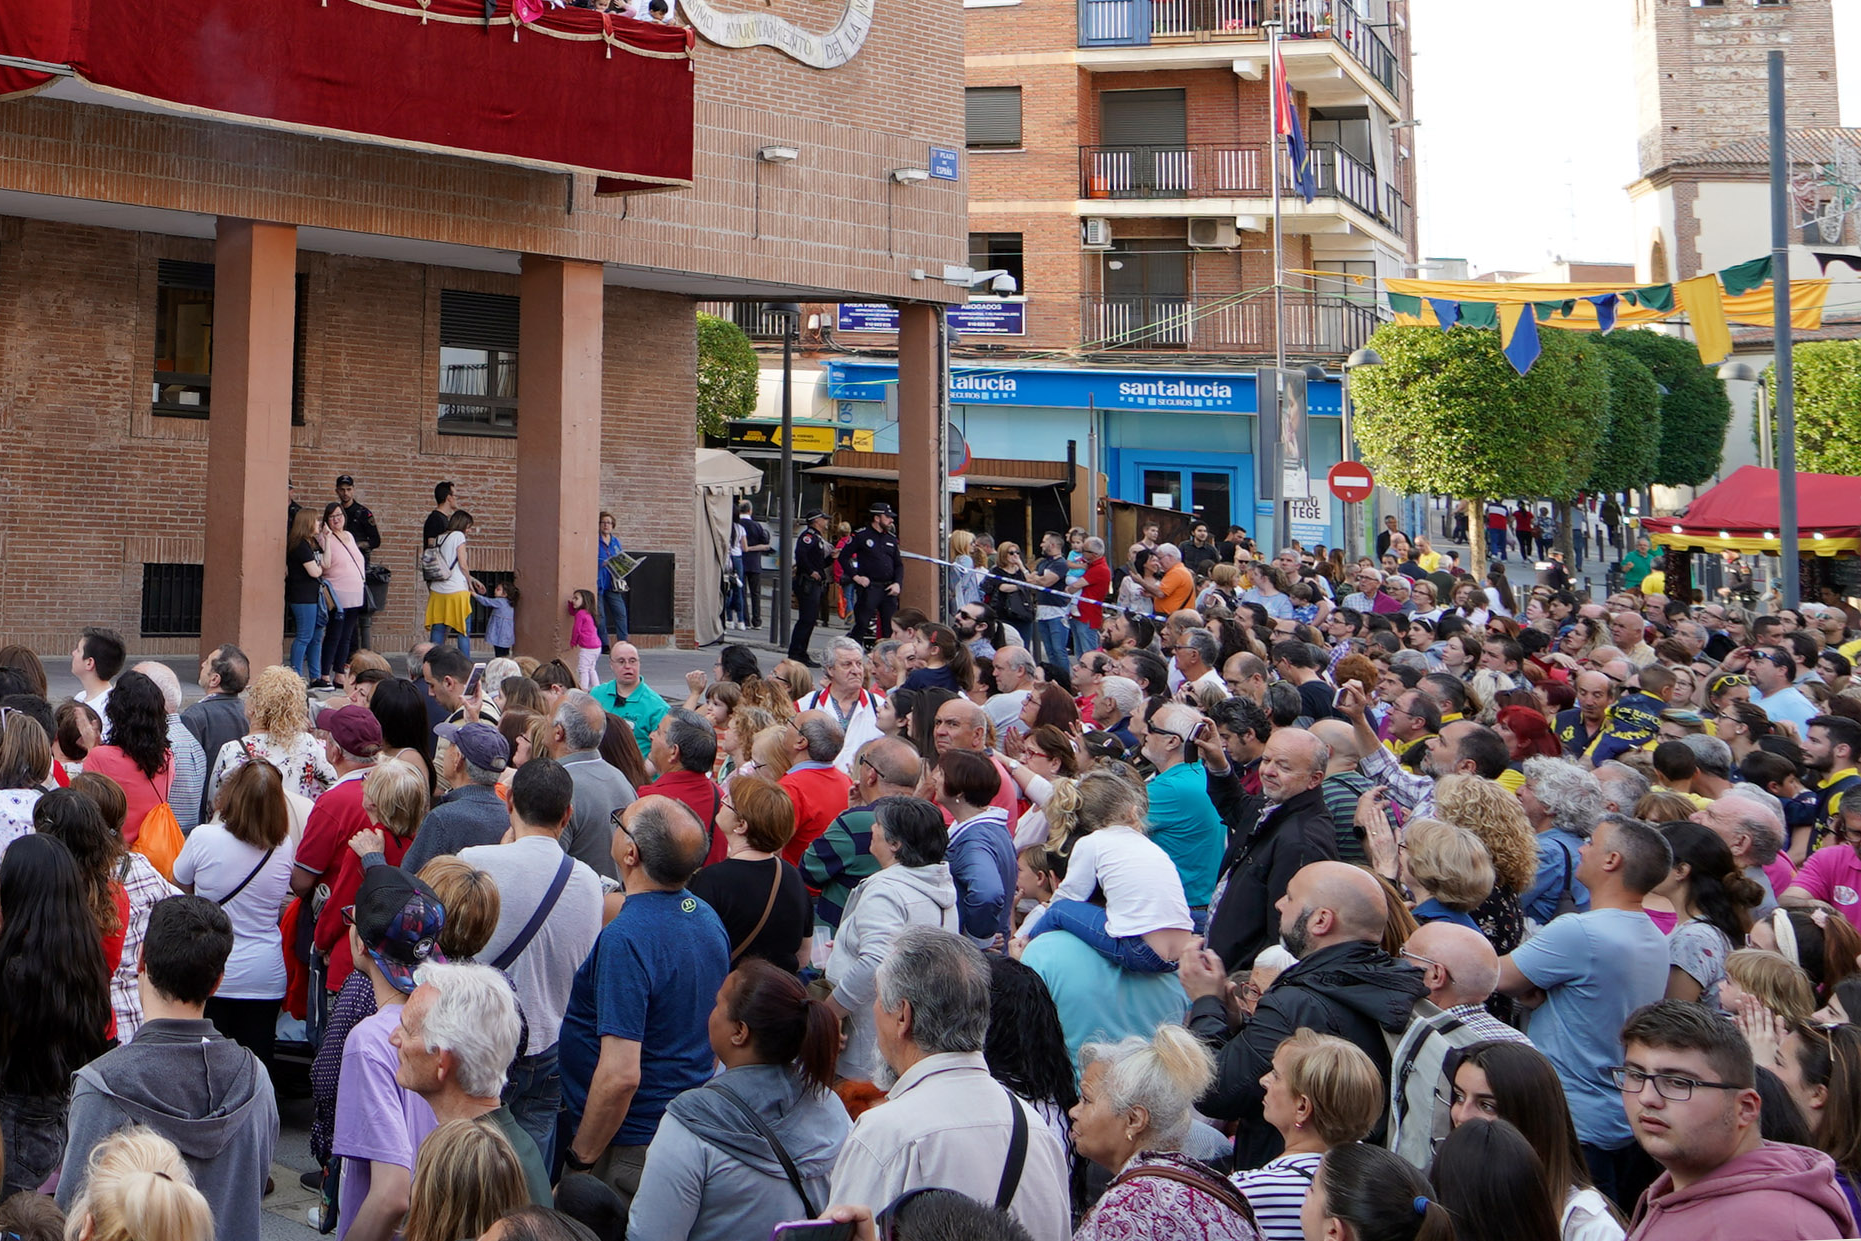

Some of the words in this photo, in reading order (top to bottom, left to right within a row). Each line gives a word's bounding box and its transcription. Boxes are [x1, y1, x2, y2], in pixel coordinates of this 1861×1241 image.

[825, 40, 843, 60] DE
[845, 22, 862, 45] LA
[960, 303, 1002, 311] ABOGADOS
[1119, 380, 1232, 398] santalucía
[1157, 398, 1193, 407] SEGUROS
[1292, 506, 1321, 520] TEGE
